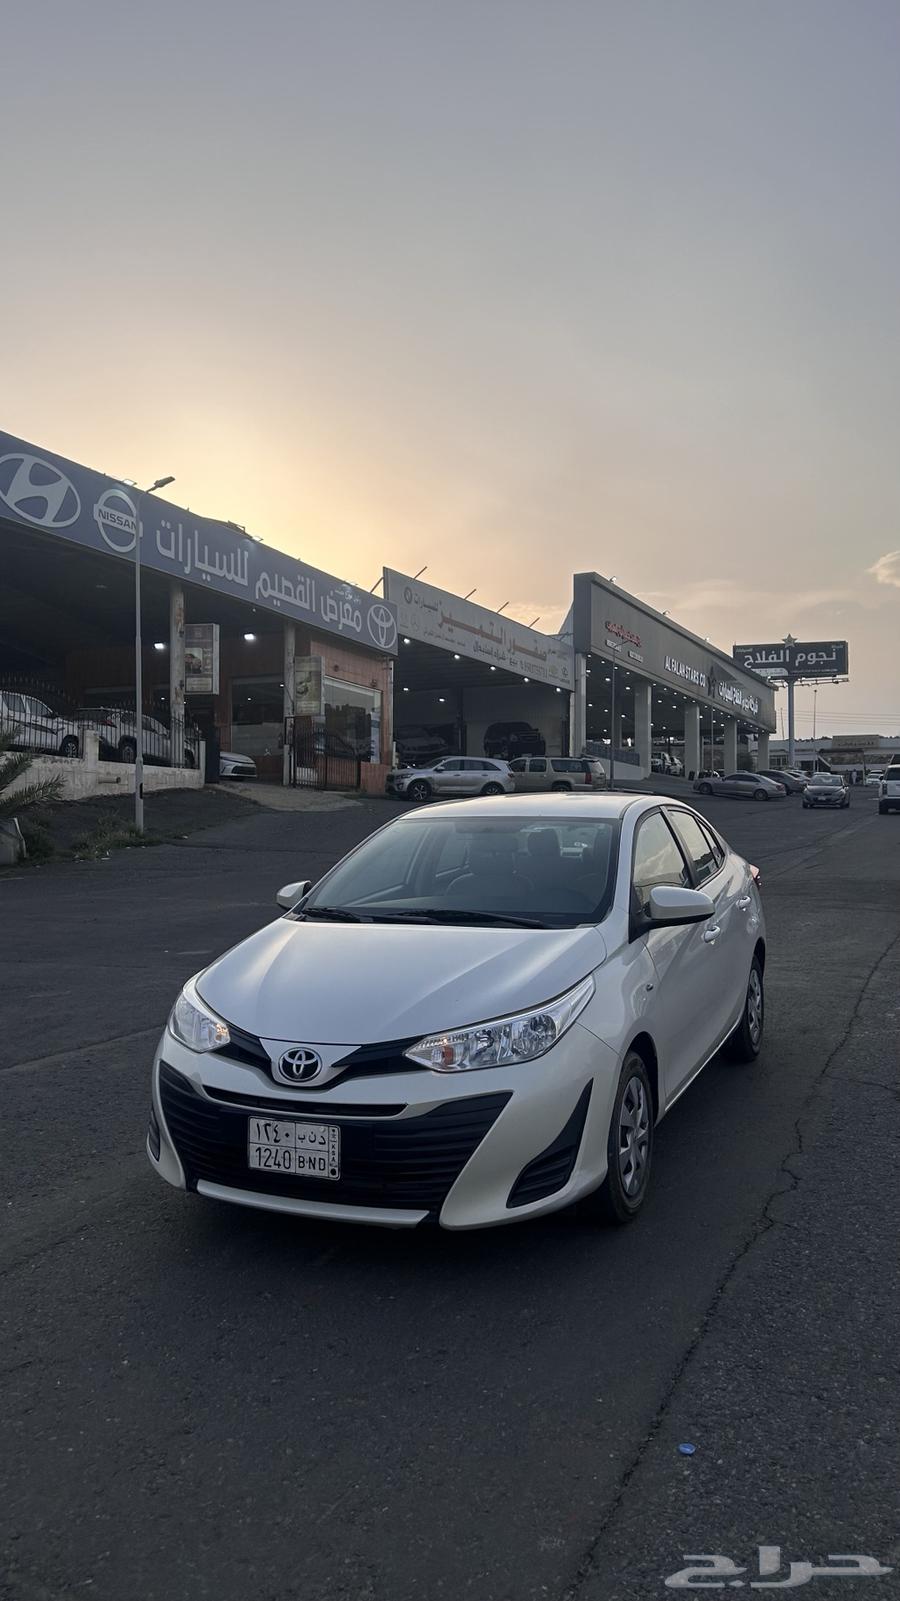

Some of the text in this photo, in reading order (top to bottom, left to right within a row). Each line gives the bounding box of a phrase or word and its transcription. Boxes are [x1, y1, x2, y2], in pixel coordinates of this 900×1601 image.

[98, 509, 137, 531] NISSAN
[156, 520, 362, 633] معرض القصيم للسيارات
[744, 648, 837, 668] نجوم الفلاح
[664, 656, 671, 671] AL
[685, 666, 699, 685] STARS
[256, 1122, 291, 1143] ١٢٤٠
[255, 1147, 327, 1171] 1240 BND
